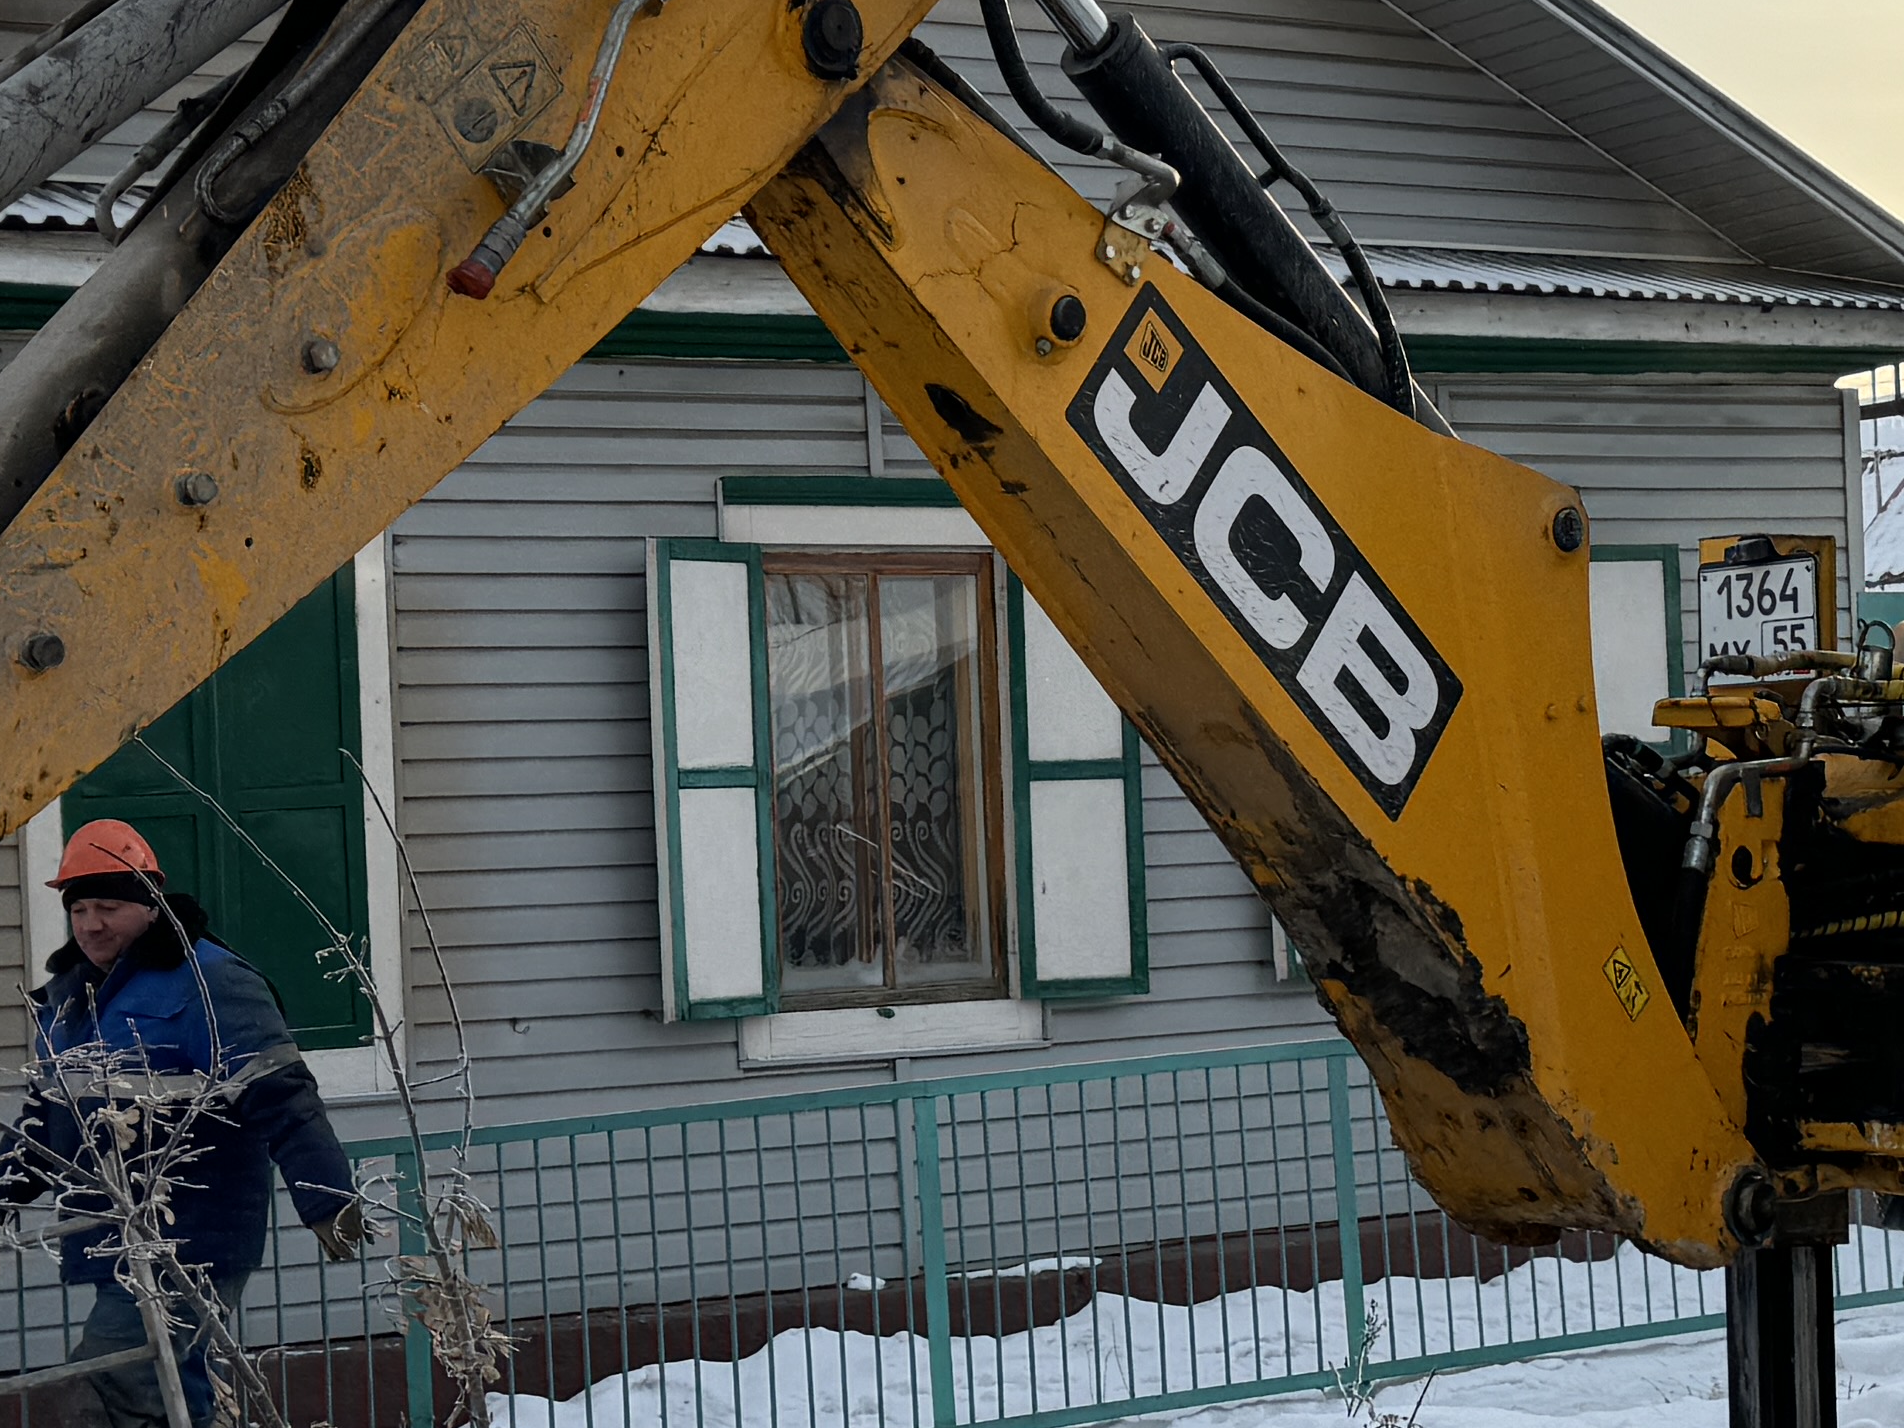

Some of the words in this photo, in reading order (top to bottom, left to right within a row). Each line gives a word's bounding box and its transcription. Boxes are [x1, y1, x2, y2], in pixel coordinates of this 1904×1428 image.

[1141, 327, 1168, 370] JCB
[1093, 367, 1439, 785] JCB
[1717, 567, 1799, 620] 1364
[1773, 623, 1807, 653] 55
